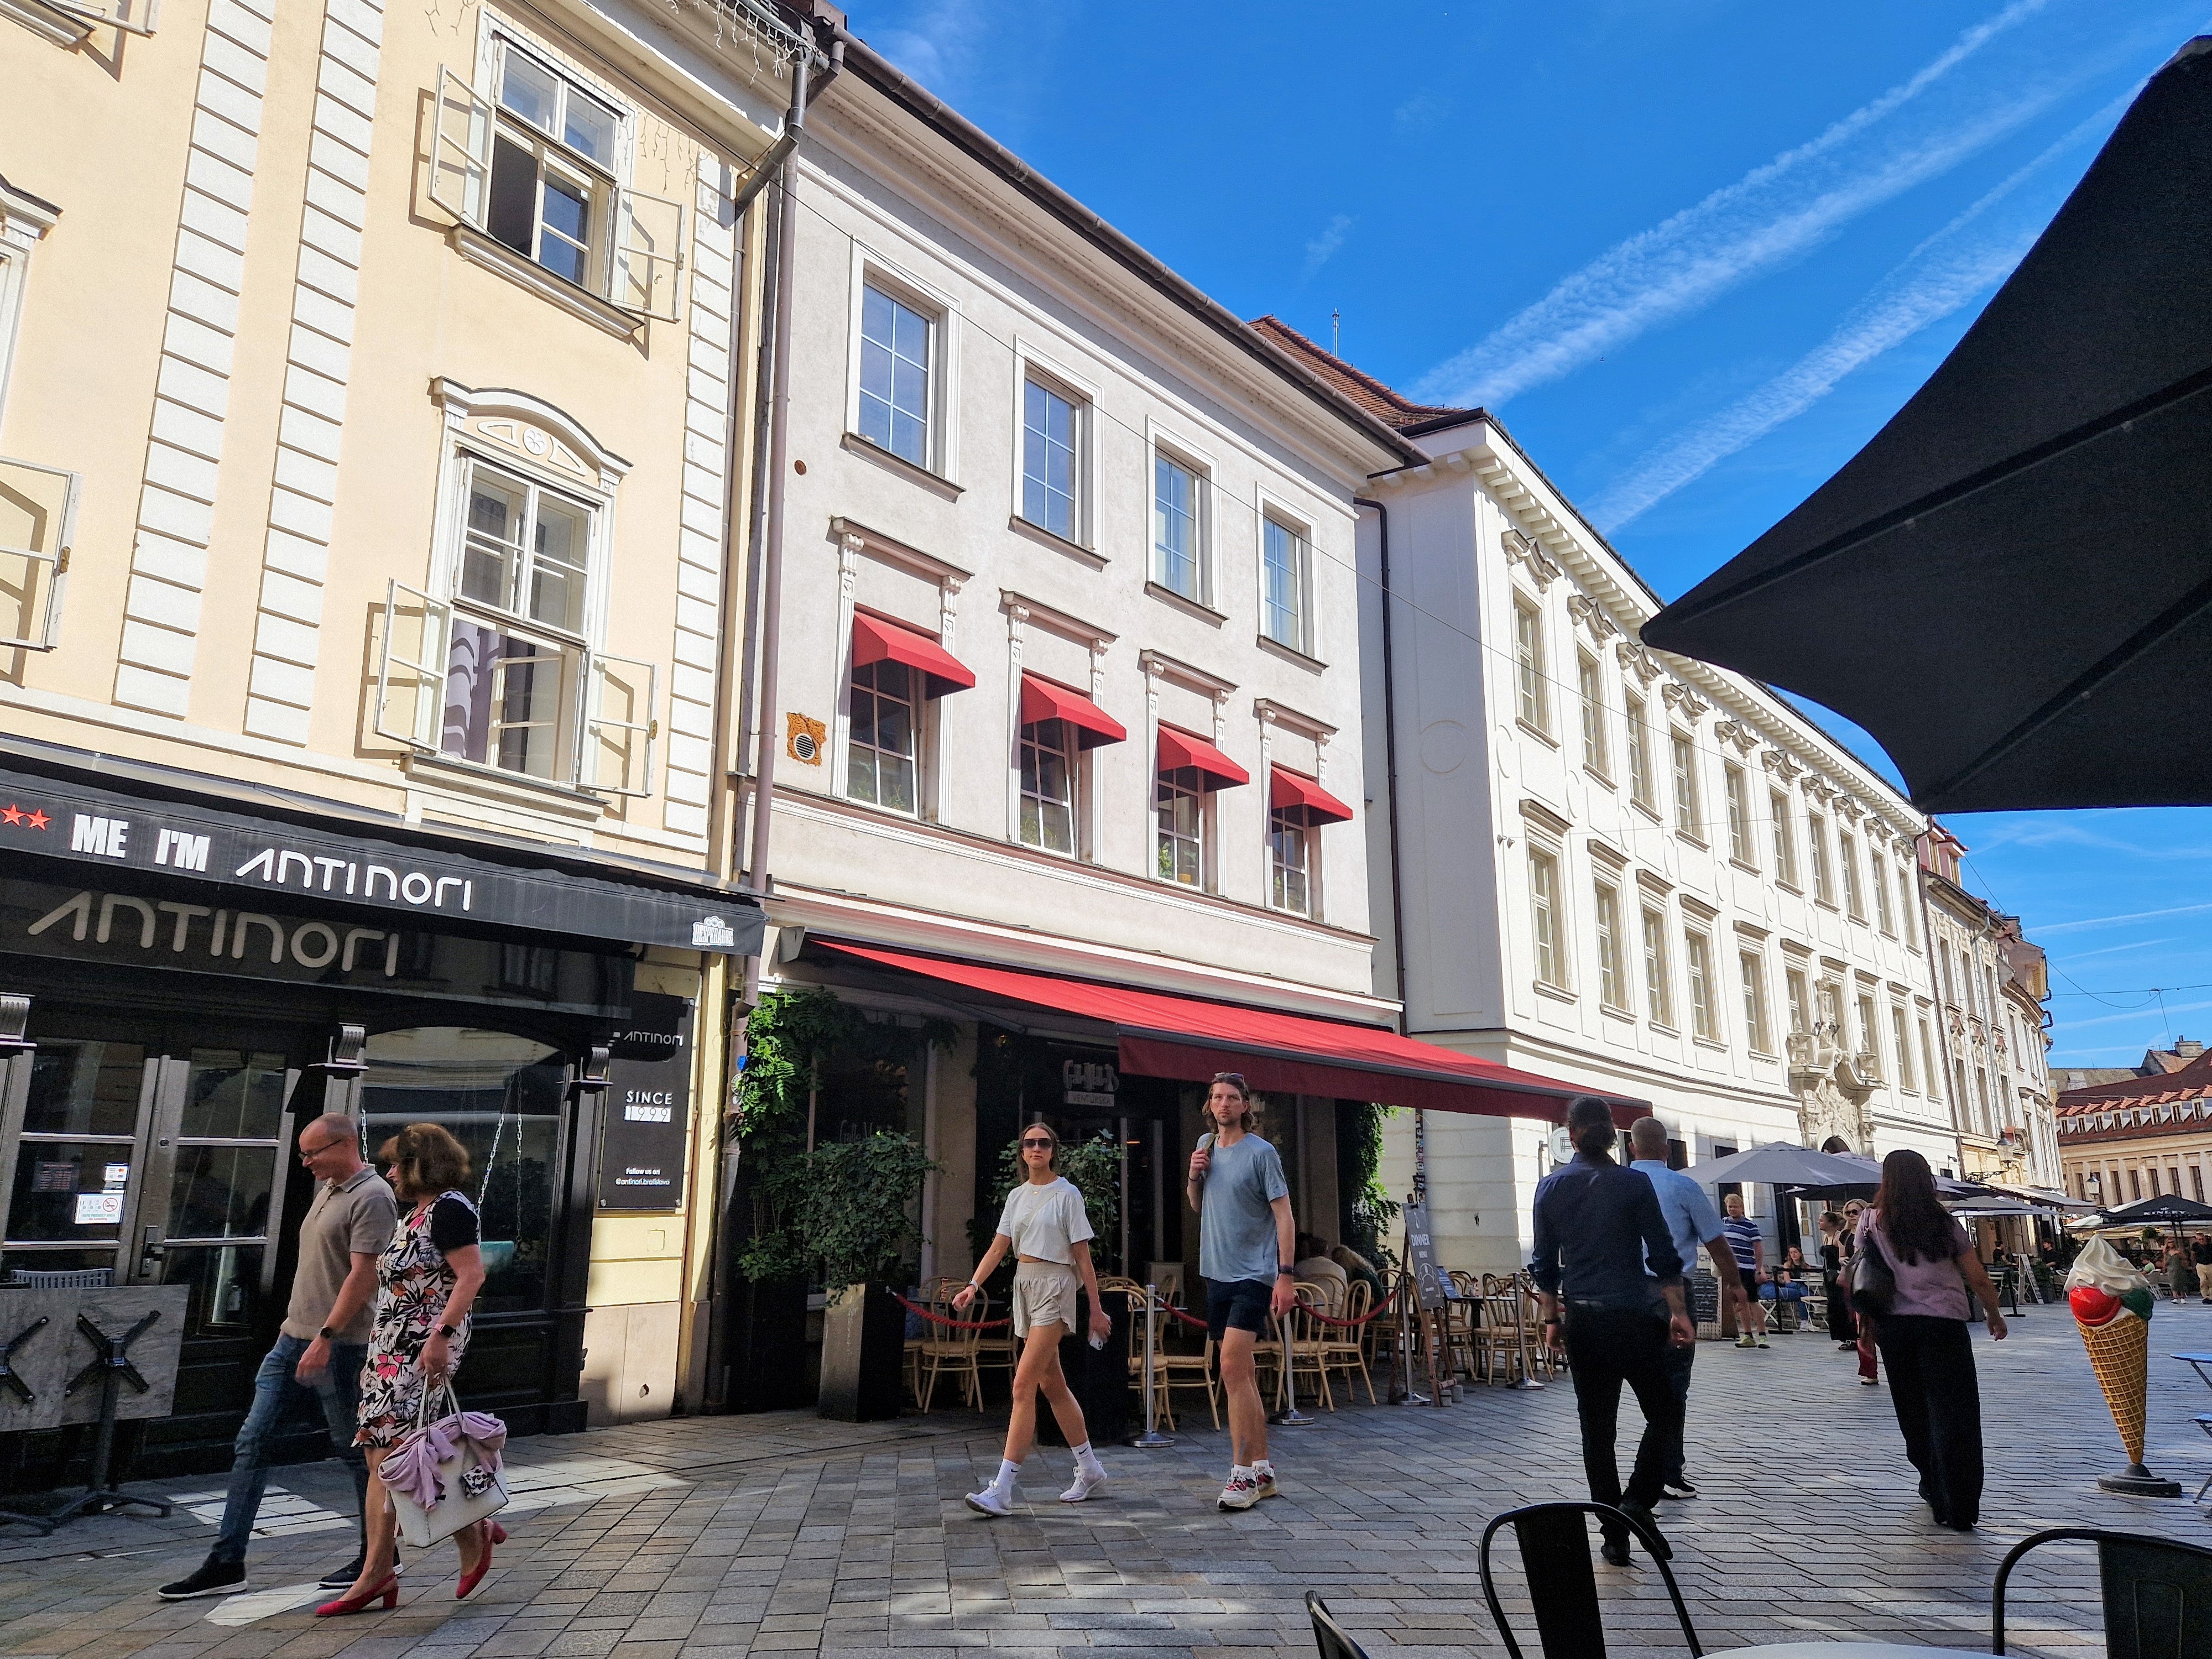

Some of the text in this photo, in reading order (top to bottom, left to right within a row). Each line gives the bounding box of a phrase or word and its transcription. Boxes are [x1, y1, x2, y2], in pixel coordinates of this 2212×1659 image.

[71, 813, 130, 858] ME
[154, 828, 211, 872] I'M
[694, 924, 733, 945] DESPERADOS
[626, 1091, 673, 1105] SINCE
[629, 1105, 668, 1122] 1999
[1411, 1234, 1431, 1246] DINNER
